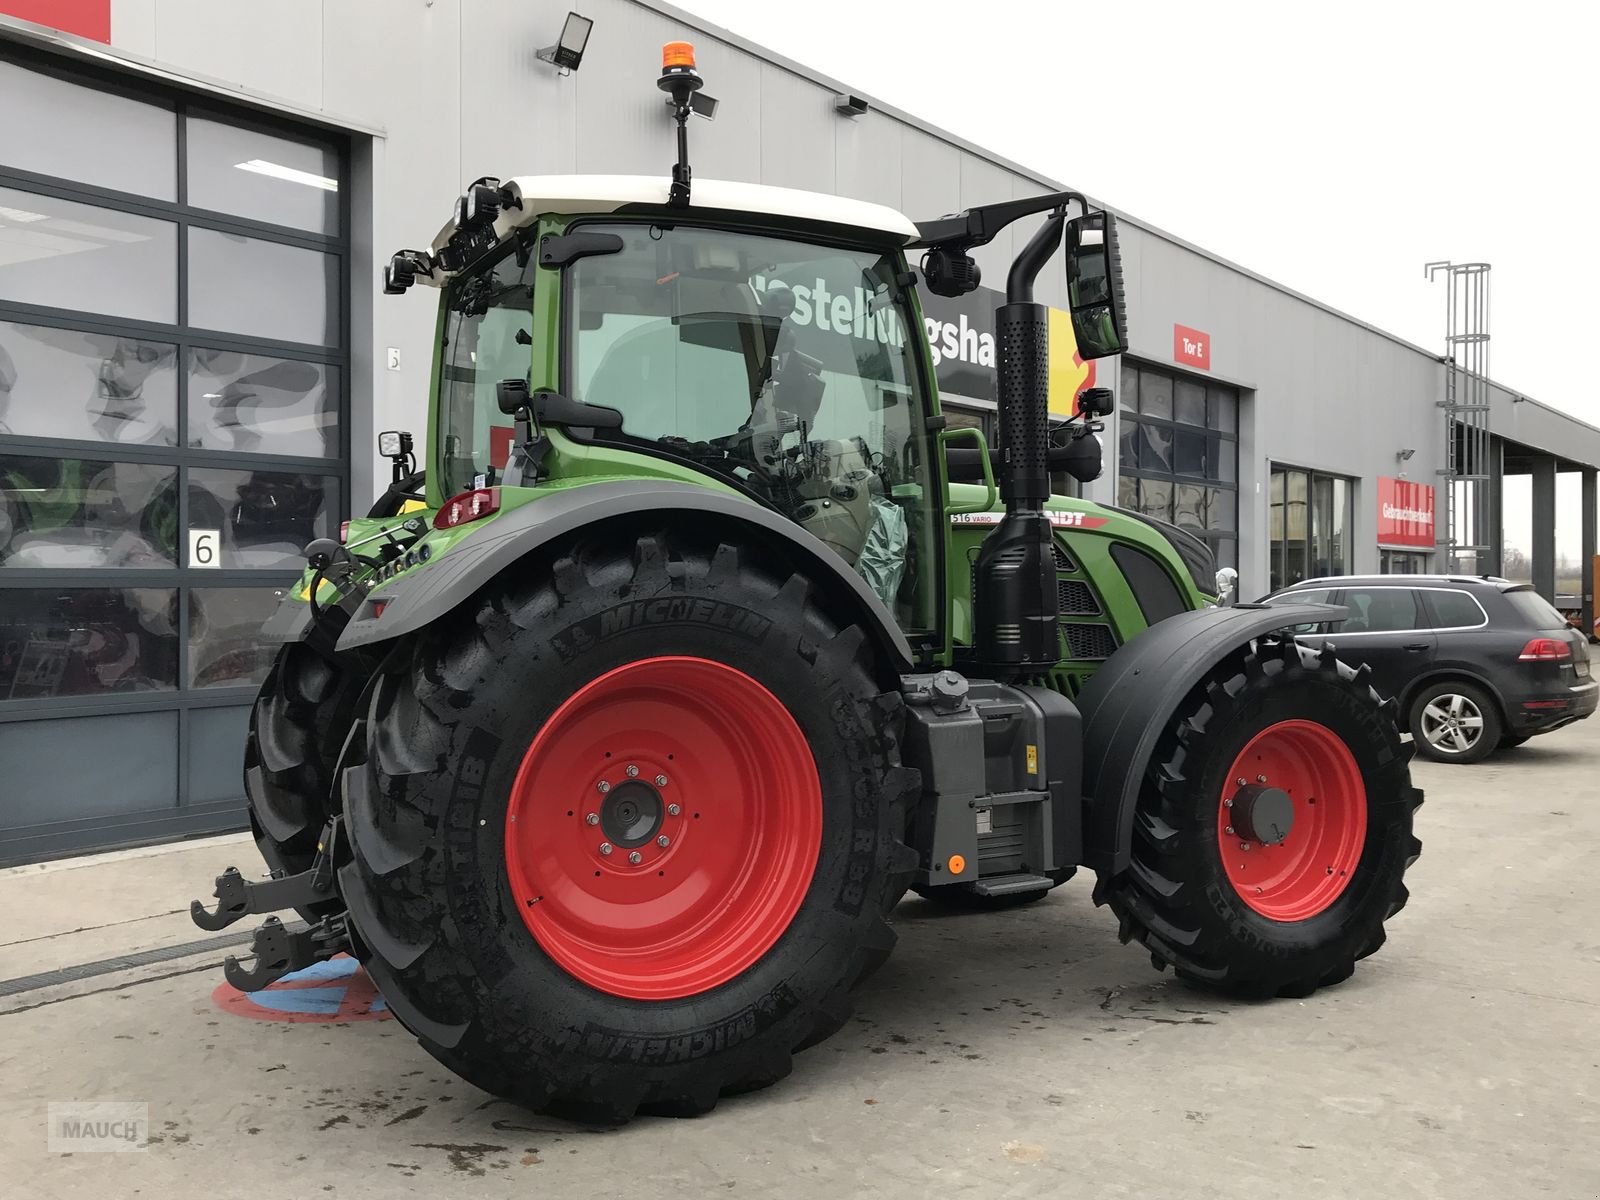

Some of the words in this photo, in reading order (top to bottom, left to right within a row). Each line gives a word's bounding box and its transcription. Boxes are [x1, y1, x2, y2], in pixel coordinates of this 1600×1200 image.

[1183, 338, 1196, 356] Tor
[1197, 342, 1203, 358] E
[953, 514, 970, 522] 516
[195, 535, 213, 564] 6
[600, 597, 773, 640] MICHELIN
